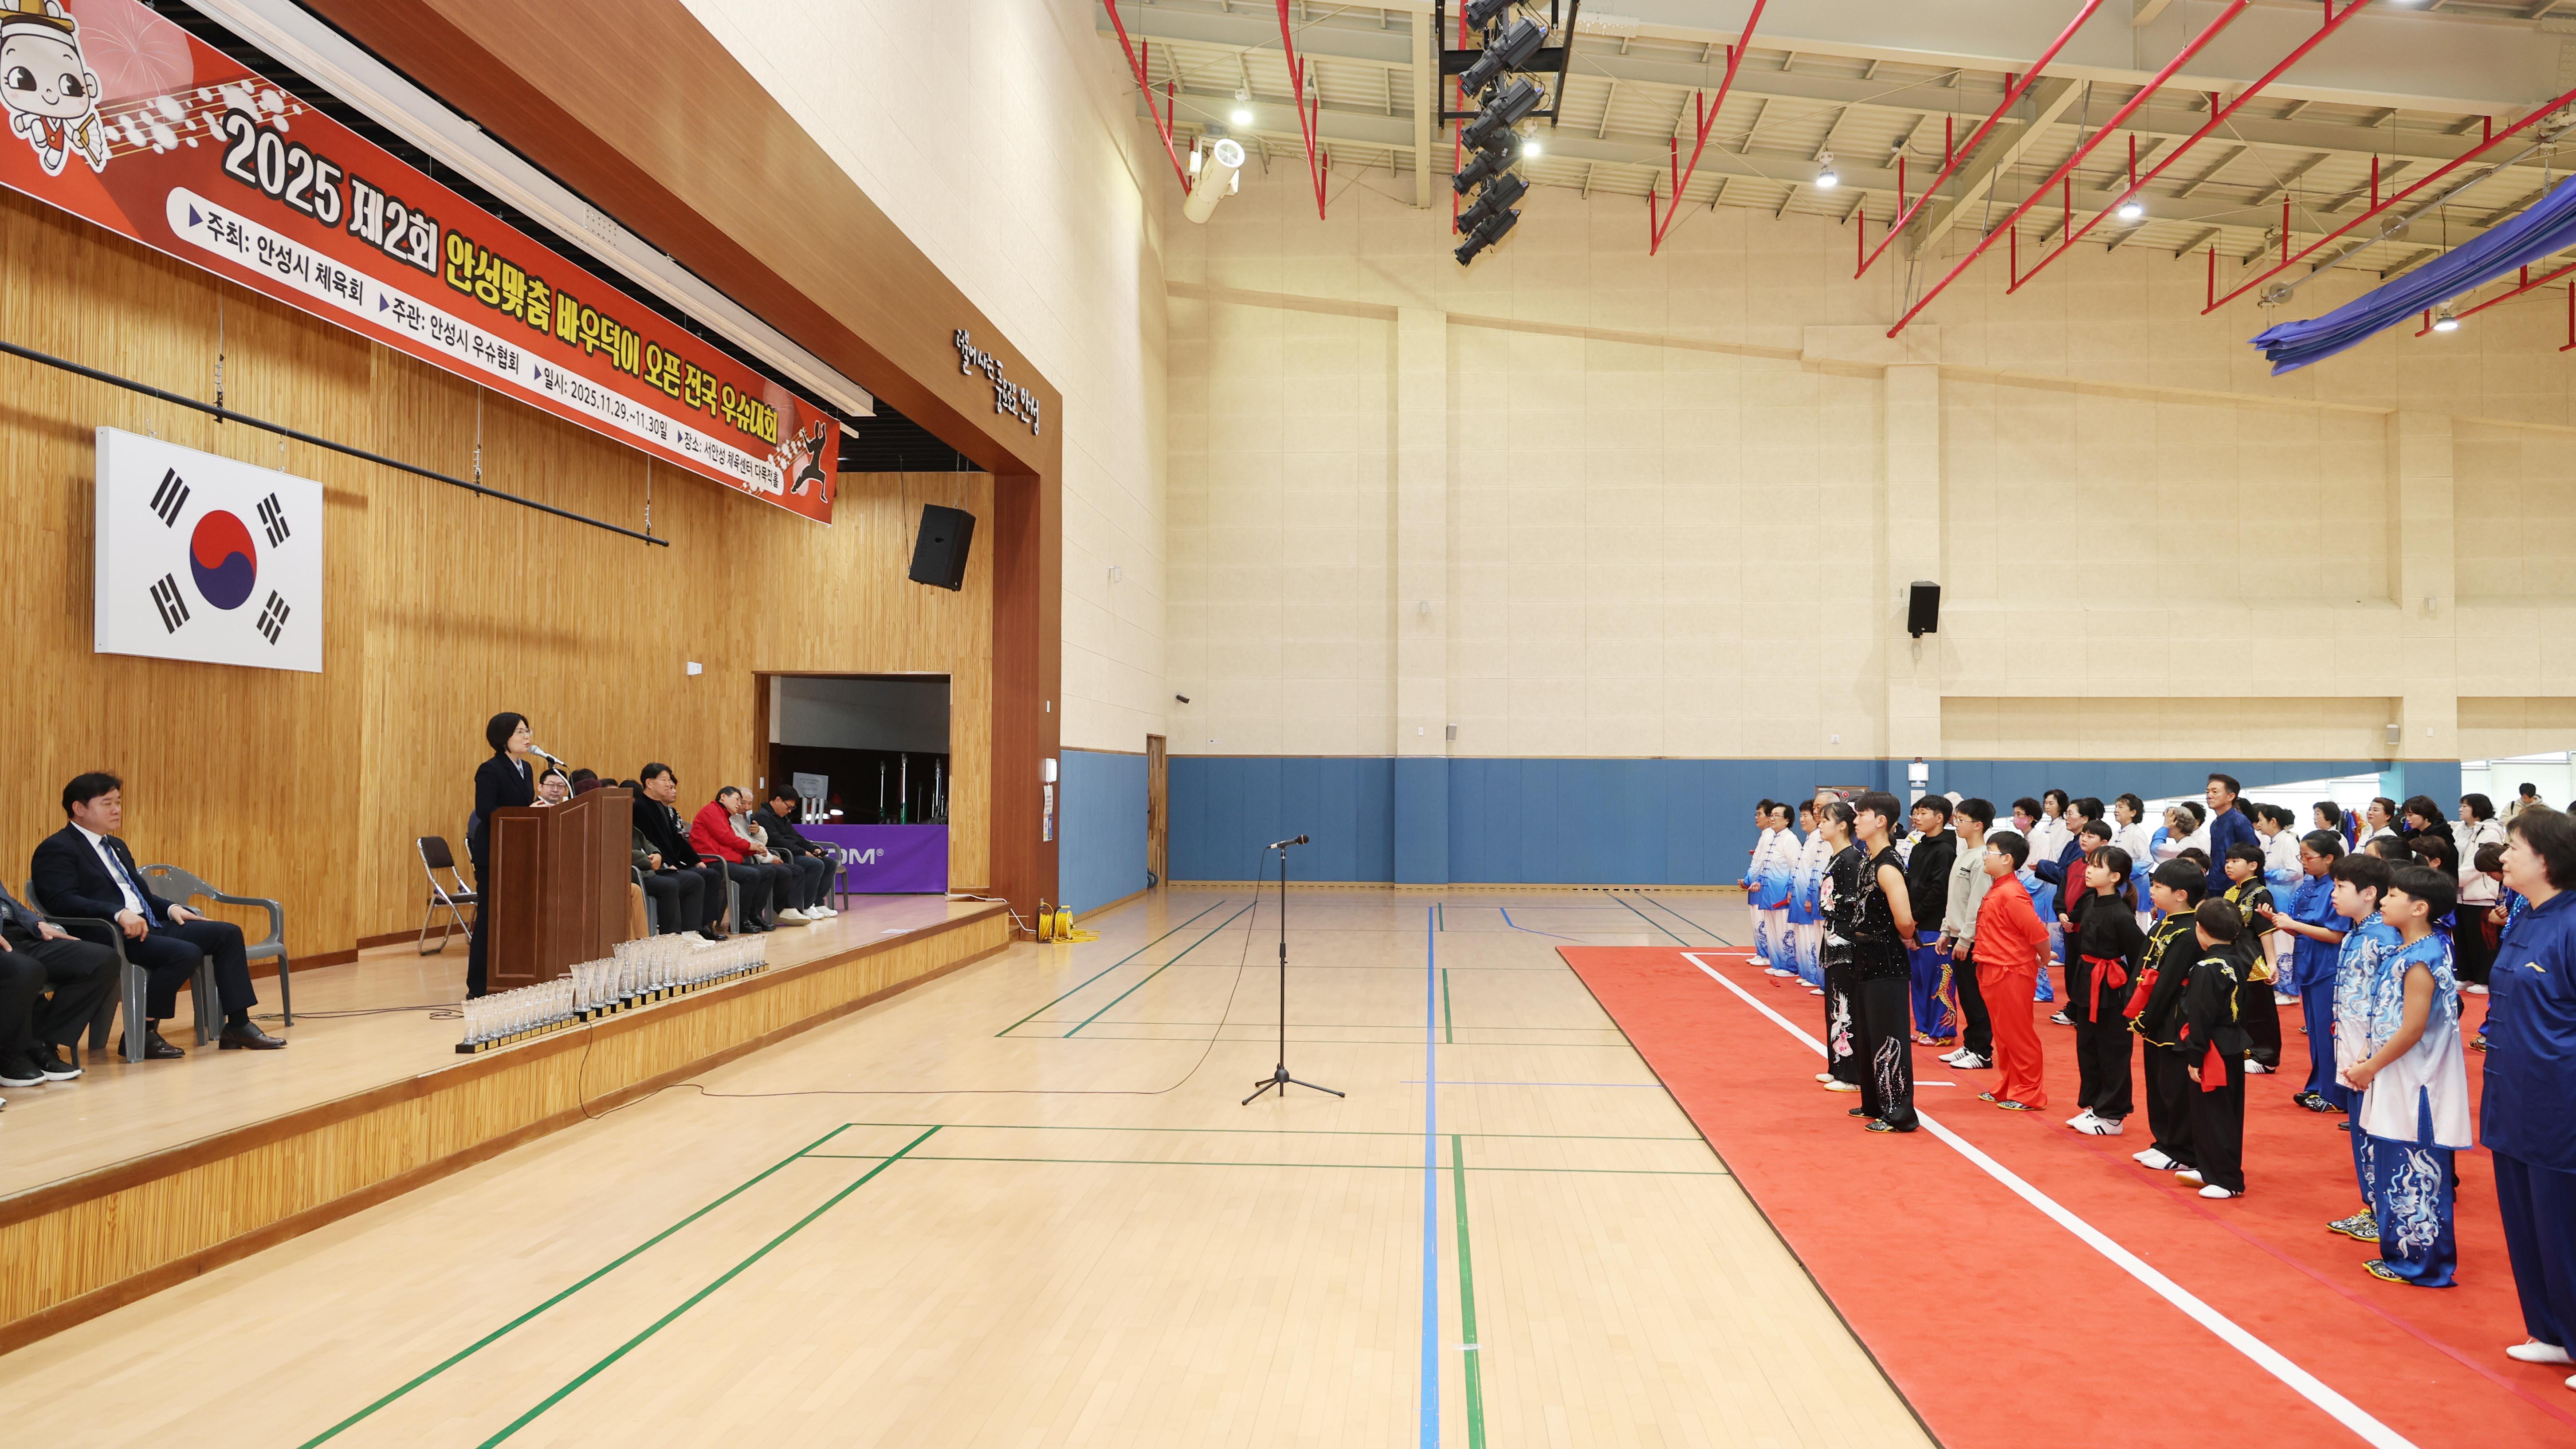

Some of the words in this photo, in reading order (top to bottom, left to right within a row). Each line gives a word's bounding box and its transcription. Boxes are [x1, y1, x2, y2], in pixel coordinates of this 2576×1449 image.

[207, 211, 249, 253] 주최:
[257, 236, 309, 283] 안성시
[315, 263, 363, 306] 체육회
[392, 298, 425, 331] 주관:
[430, 315, 468, 353] 안성시
[472, 335, 519, 375] 우슈협회
[544, 368, 567, 395] 일시:
[684, 432, 702, 453] 장소:
[704, 442, 726, 465] 서안성
[726, 451, 753, 477] 체육센터
[754, 464, 778, 489] 다목적홀
[224, 113, 342, 224] 2025
[349, 178, 438, 273] 제2회
[446, 233, 551, 332] 안성맞춤
[555, 292, 641, 376] 바우덕이
[644, 344, 681, 397] 오픈
[685, 363, 718, 416] 전국
[720, 385, 778, 445] 우슈대회
[954, 328, 977, 376] 더불어
[977, 350, 995, 380] 사는
[1020, 387, 1040, 436] 안성
